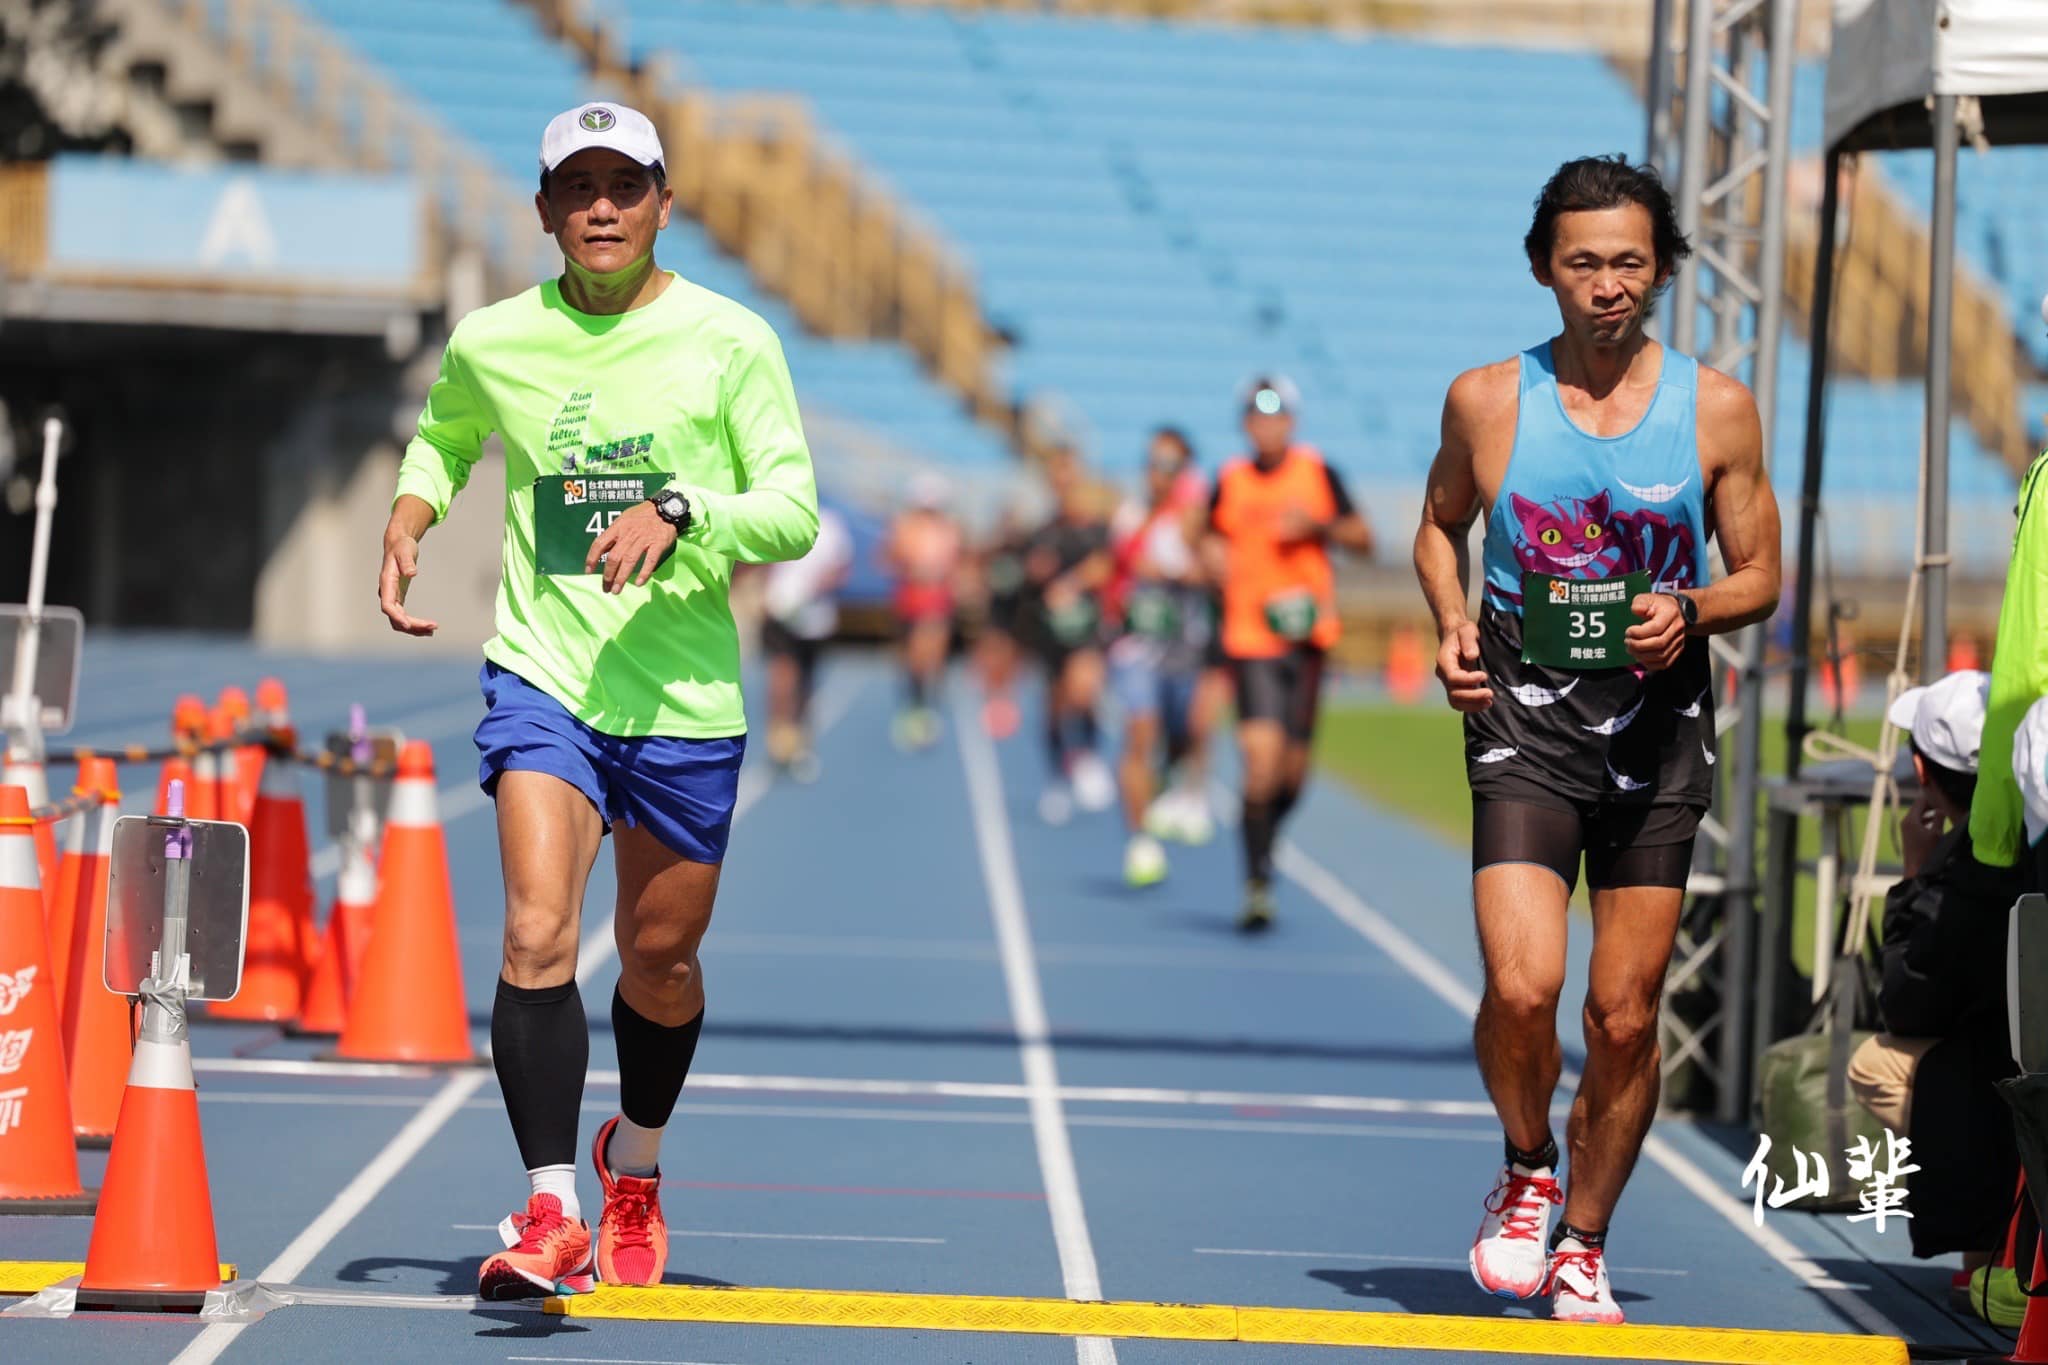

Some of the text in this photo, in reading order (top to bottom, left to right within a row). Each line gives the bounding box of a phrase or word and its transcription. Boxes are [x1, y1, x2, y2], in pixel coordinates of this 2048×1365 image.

[200, 174, 277, 270] A
[569, 391, 592, 402] Run
[553, 415, 587, 427] Taiwan
[549, 428, 581, 442] Ultra
[547, 440, 583, 452] Marathon
[1568, 611, 1607, 639] 35
[1570, 647, 1607, 660] 周俊宏
